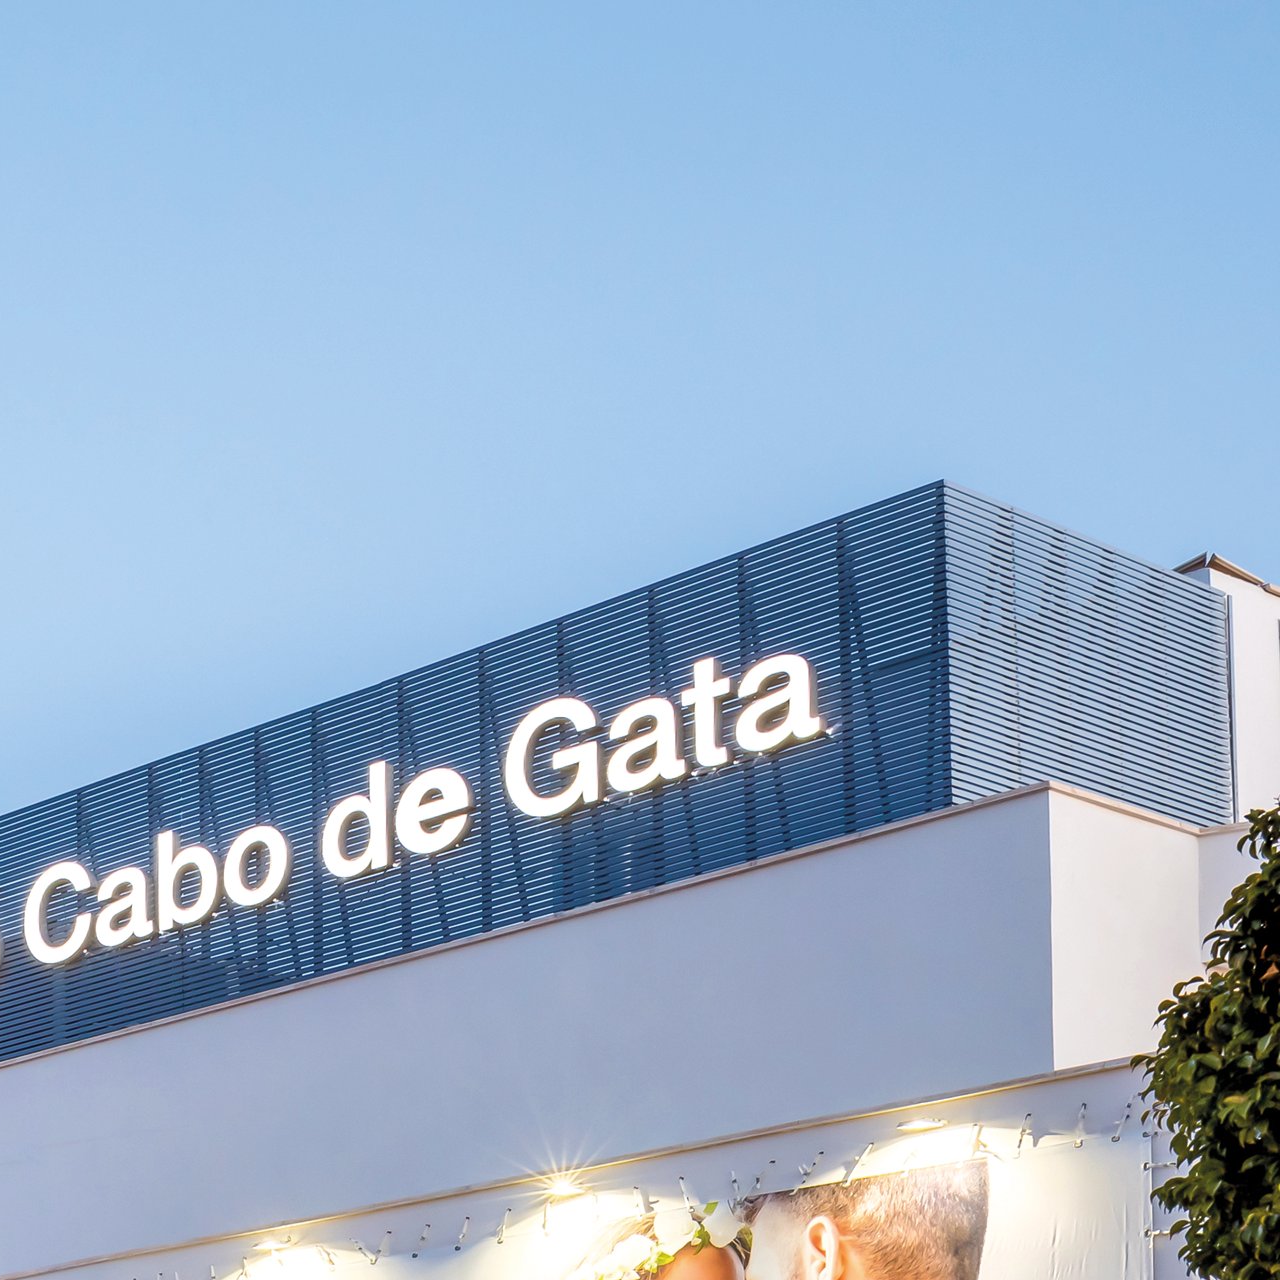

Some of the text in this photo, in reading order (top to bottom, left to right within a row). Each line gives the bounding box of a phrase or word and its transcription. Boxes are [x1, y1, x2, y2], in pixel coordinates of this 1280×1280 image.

[22, 832, 290, 968] Cabo
[321, 759, 474, 880] de
[503, 652, 830, 819] Gata
